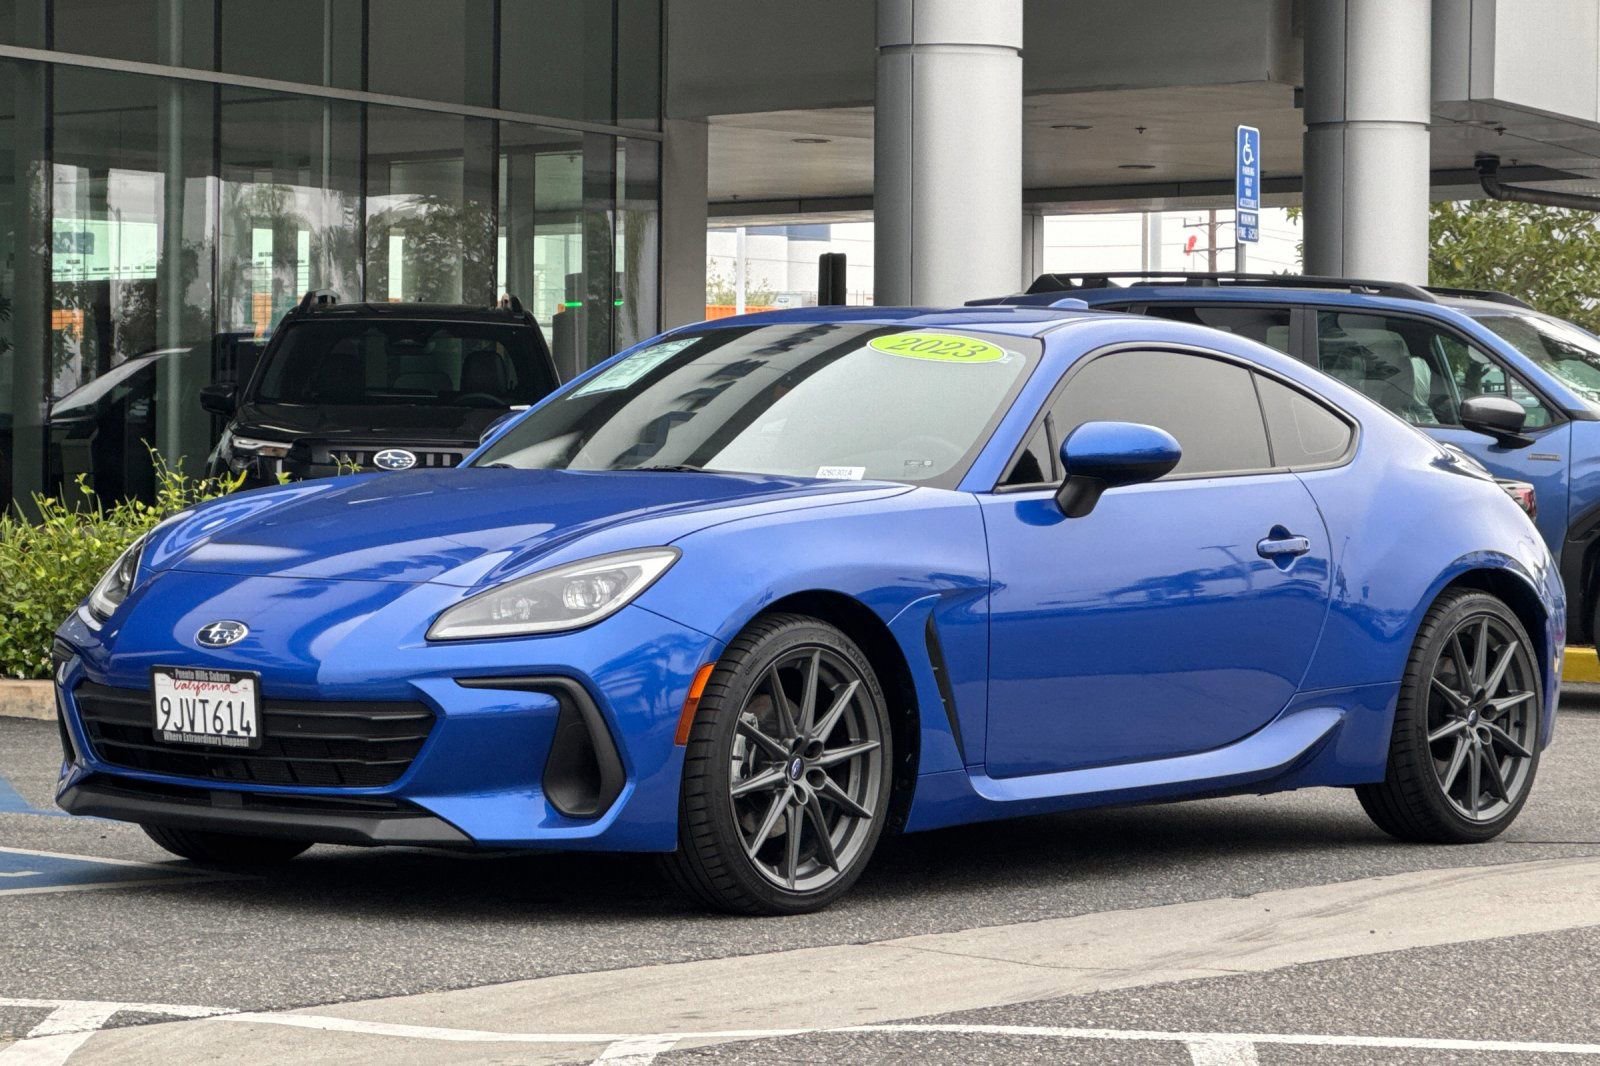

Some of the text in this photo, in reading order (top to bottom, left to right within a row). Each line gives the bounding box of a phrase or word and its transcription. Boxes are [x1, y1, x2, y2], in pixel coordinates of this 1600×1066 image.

[884, 337, 989, 358] 2023
[195, 670, 208, 680] Hills
[209, 671, 230, 682] Subaru
[174, 680, 239, 696] California
[160, 697, 252, 735] 9JVT614
[163, 731, 182, 741] Where
